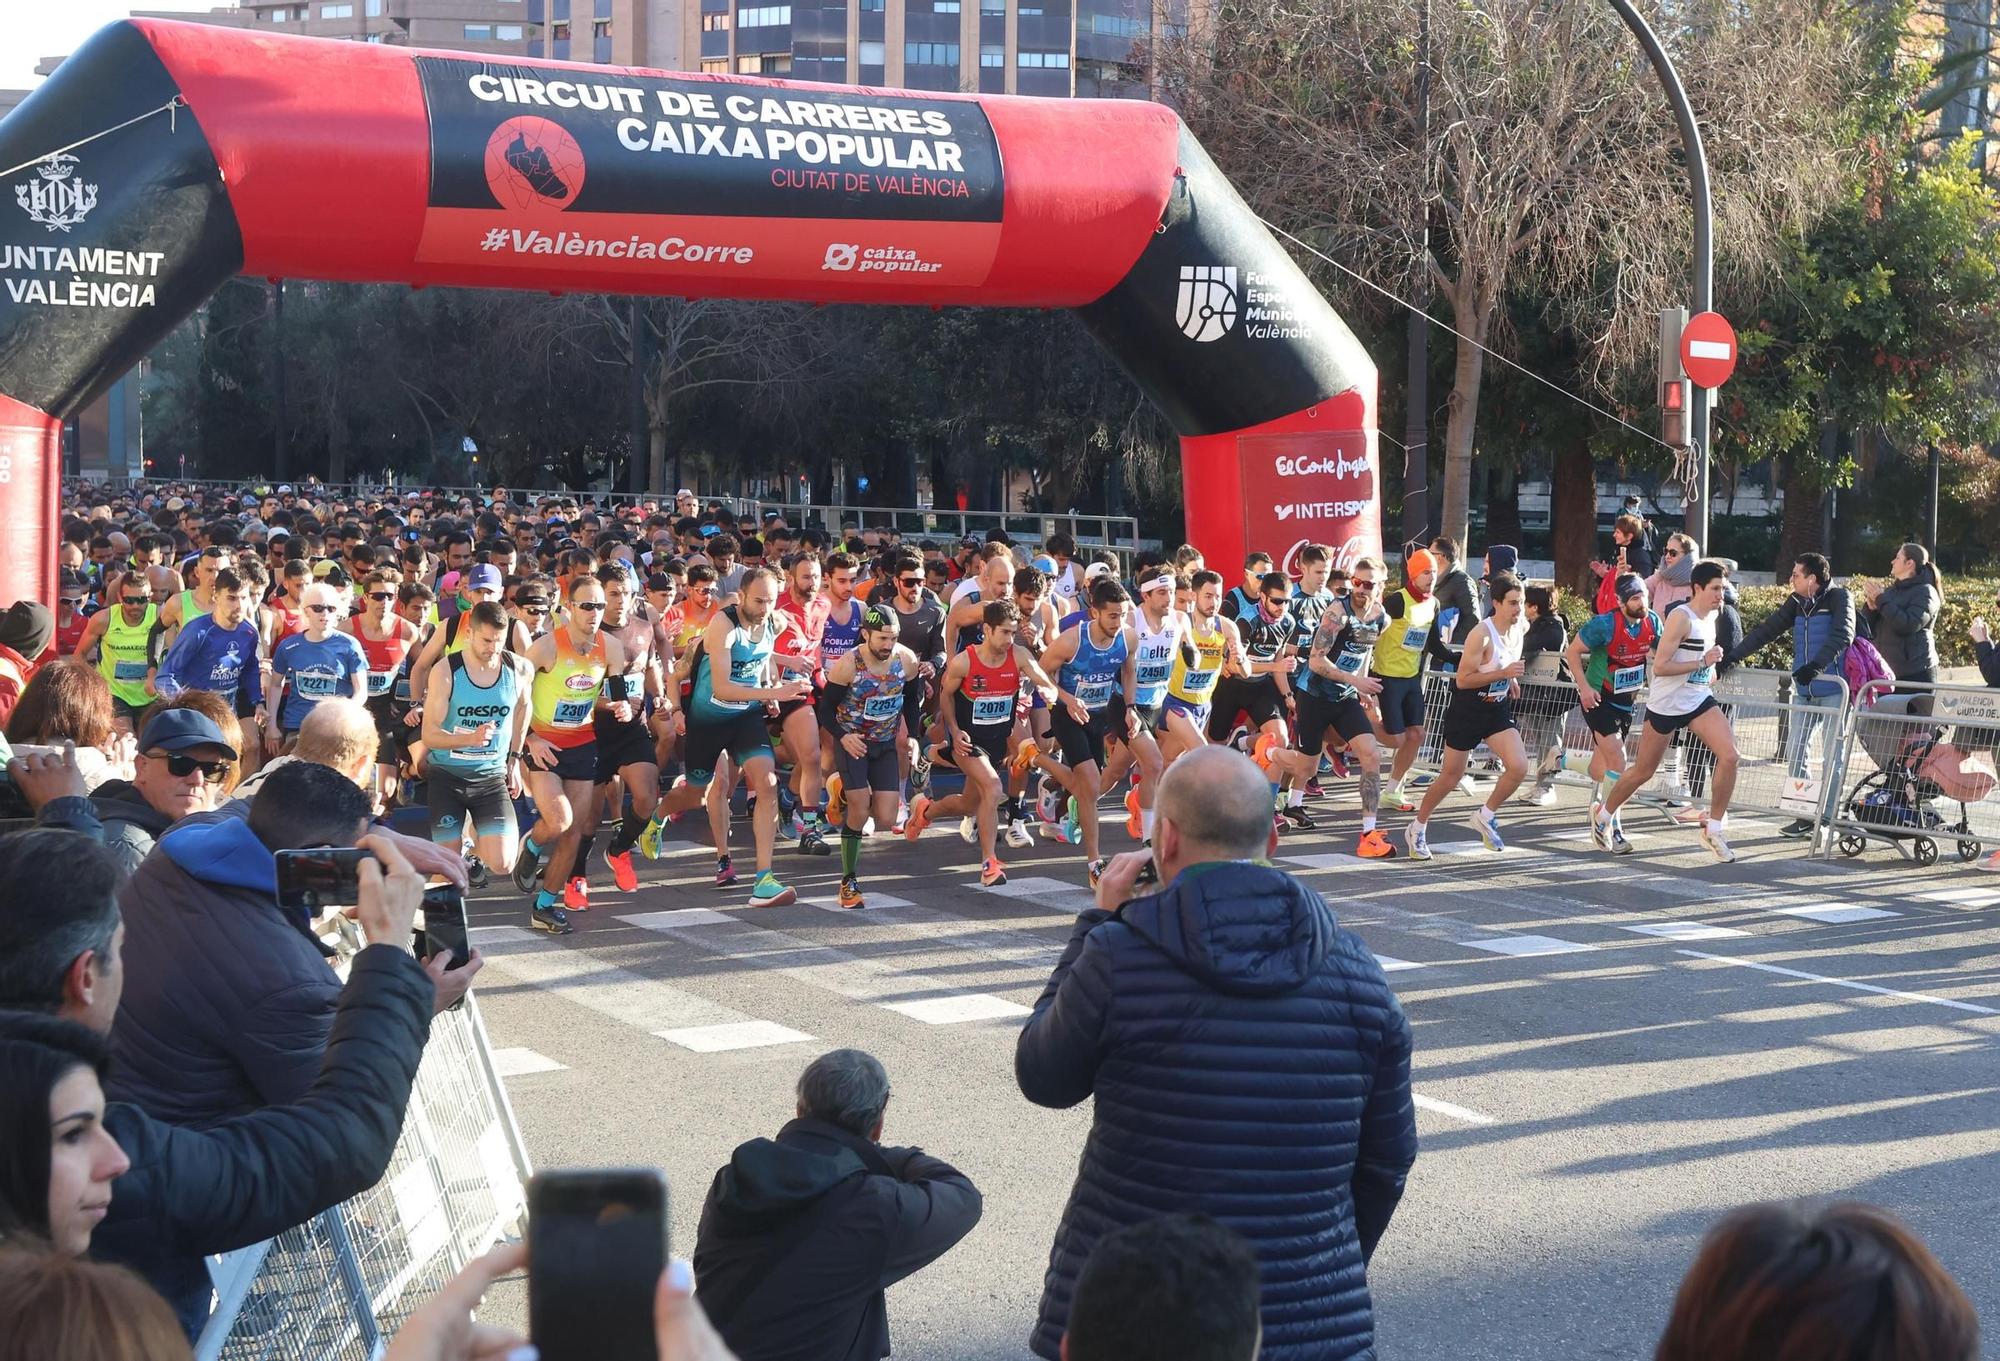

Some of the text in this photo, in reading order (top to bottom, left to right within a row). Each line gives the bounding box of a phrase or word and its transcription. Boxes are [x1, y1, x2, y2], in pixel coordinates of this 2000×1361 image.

[468, 74, 953, 137] CIRCUIT DE CARRERES
[771, 168, 969, 198] CIUTAT DE VALÈNCIA
[480, 227, 754, 264] #ValènciaCorre
[863, 246, 916, 261] caixa
[857, 259, 942, 273] popular
[5, 275, 156, 308] VALÈNCIA
[1245, 323, 1313, 338] València
[1275, 456, 1296, 476] El
[1295, 455, 1335, 475] Corte
[1140, 645, 1171, 660] Delta
[303, 677, 328, 689] 2221
[367, 676, 386, 687] 189
[457, 705, 510, 717] CRESPO
[980, 701, 1006, 714] 2078
